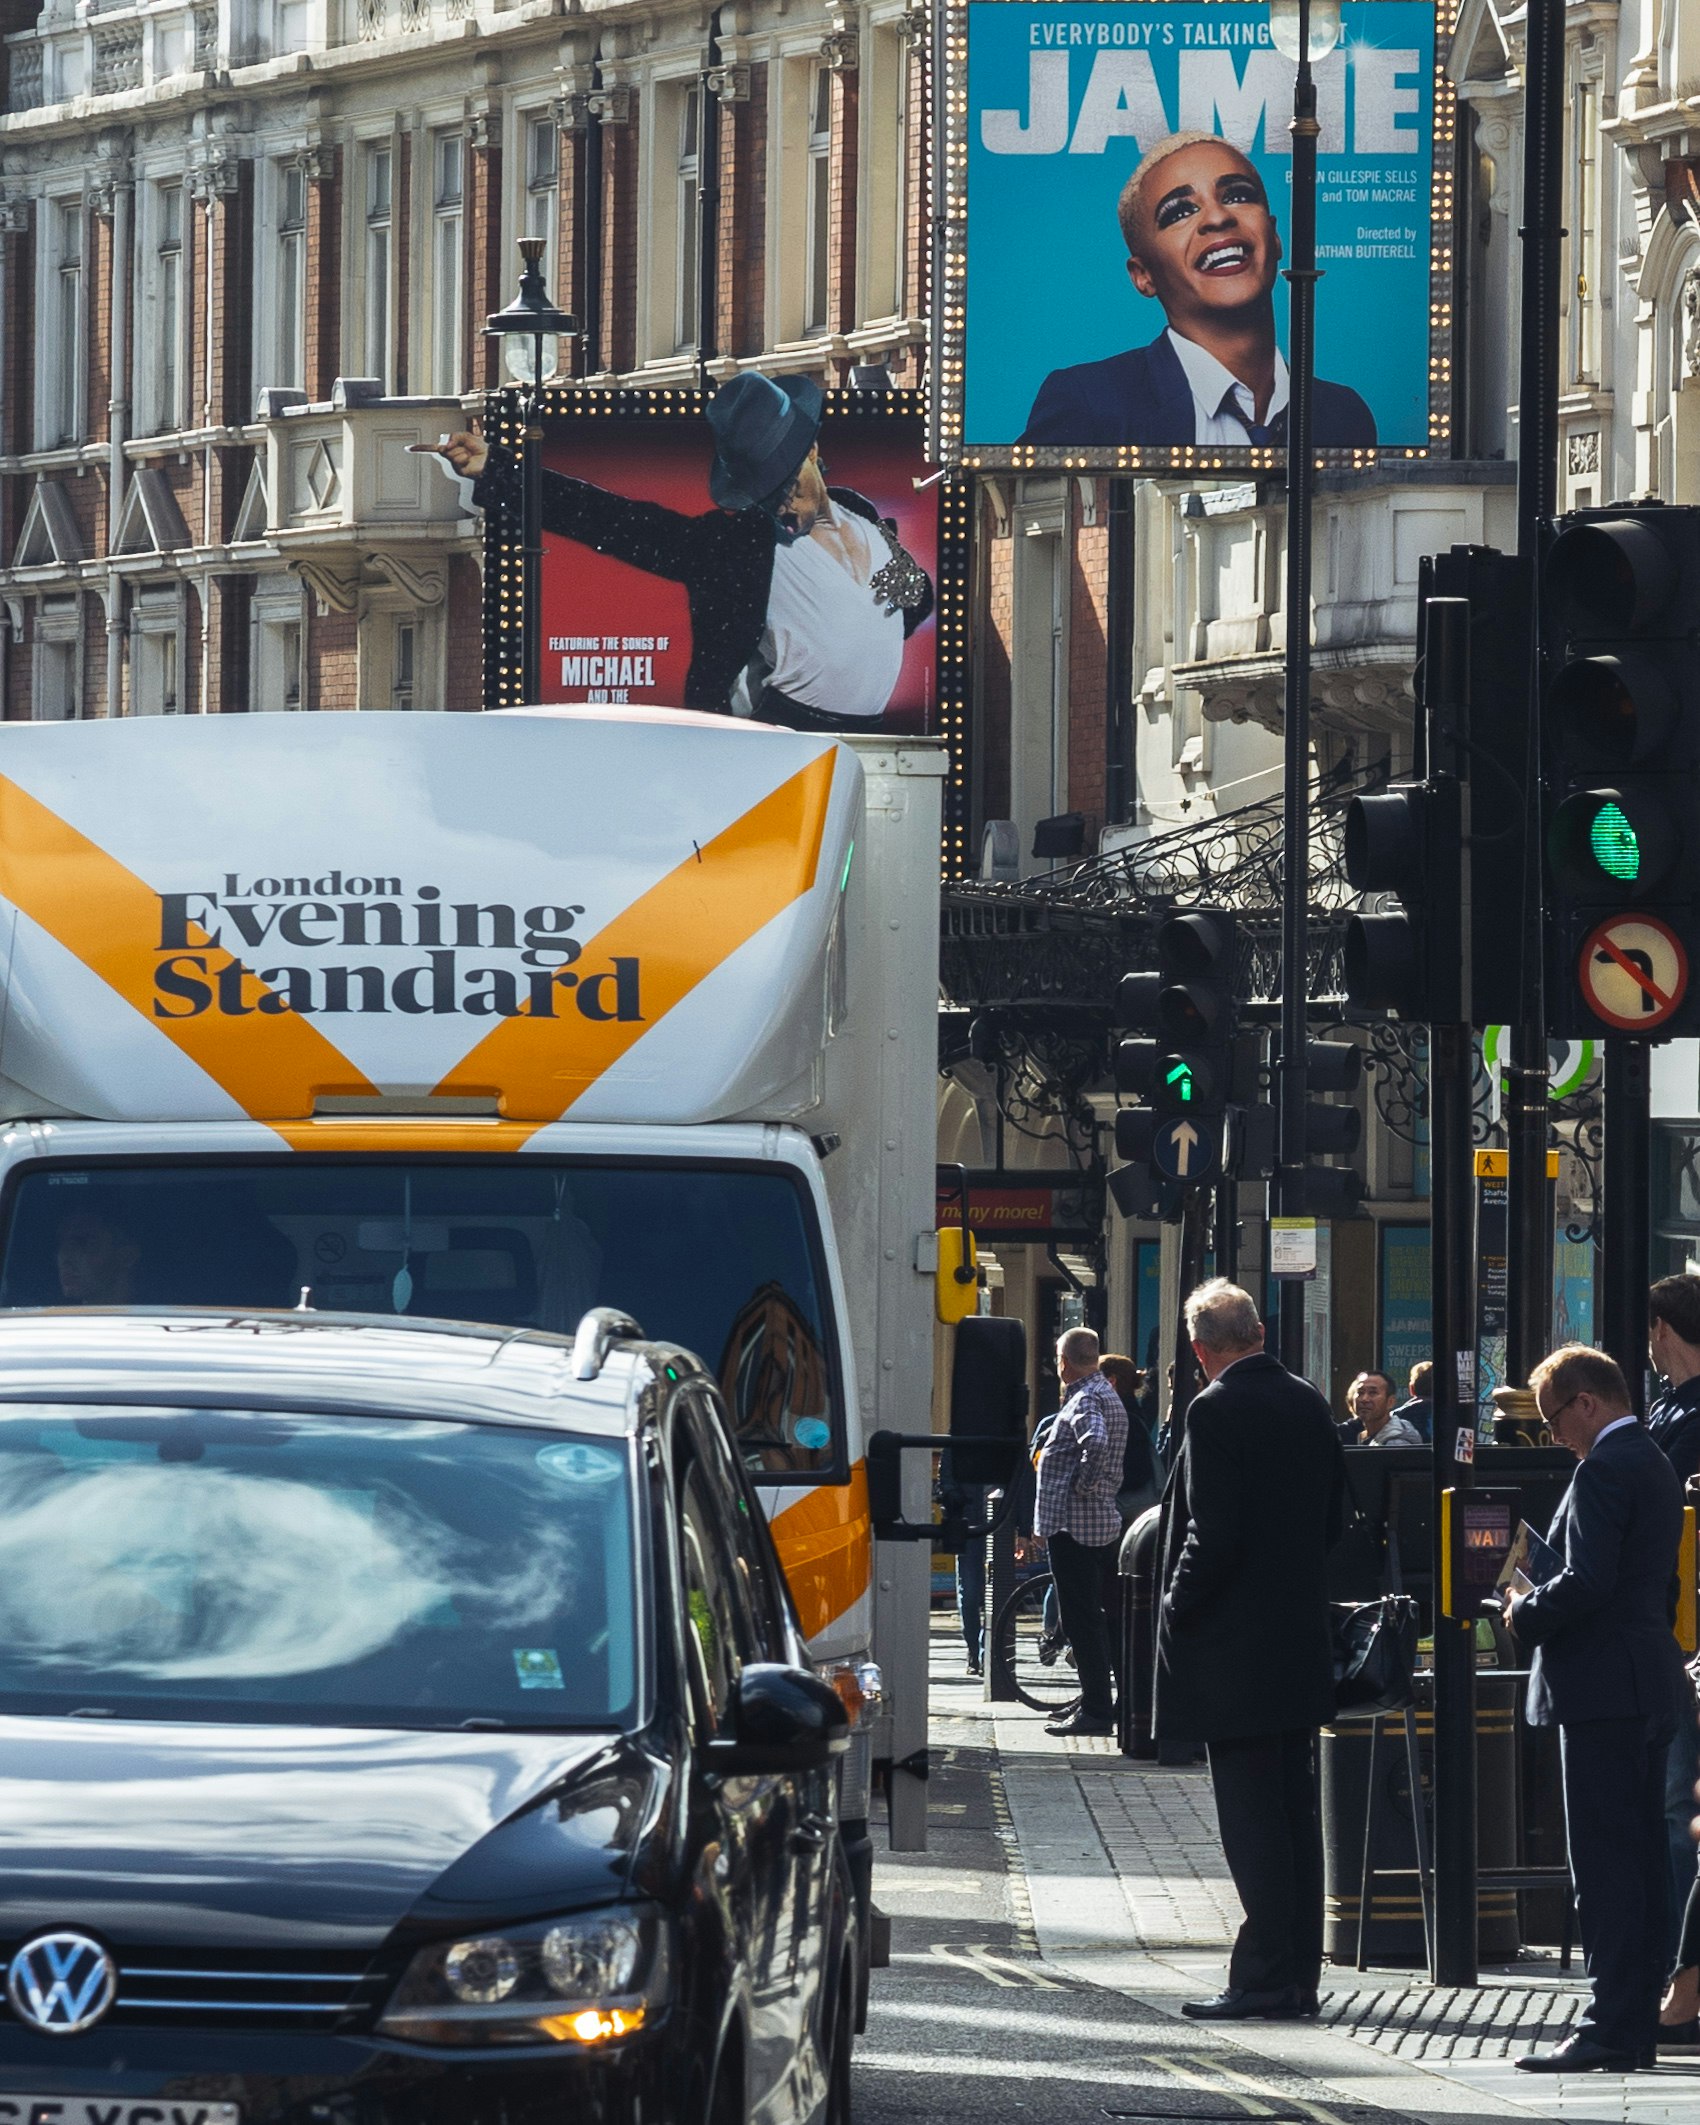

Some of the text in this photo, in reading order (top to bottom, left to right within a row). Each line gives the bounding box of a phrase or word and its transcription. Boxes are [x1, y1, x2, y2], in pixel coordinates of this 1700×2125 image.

[1030, 22, 1269, 46] EVERYBODY’S TALKING
[981, 49, 1420, 154] JAMIE
[1328, 170, 1381, 184] GILLESPIE
[1385, 170, 1418, 184] SELLS
[1322, 189, 1417, 203] and TOM MACRAE
[1357, 227, 1417, 241] Directed by
[1356, 245, 1416, 258] BUTTERELL
[549, 636, 669, 651] FEATURING THE SONGS OF
[562, 656, 655, 686] MICHAEL
[588, 689, 629, 704] AND THE
[223, 871, 404, 897] London
[154, 886, 585, 968] Evening
[154, 949, 646, 1022] Standard
[993, 1204, 1045, 1220] more!
